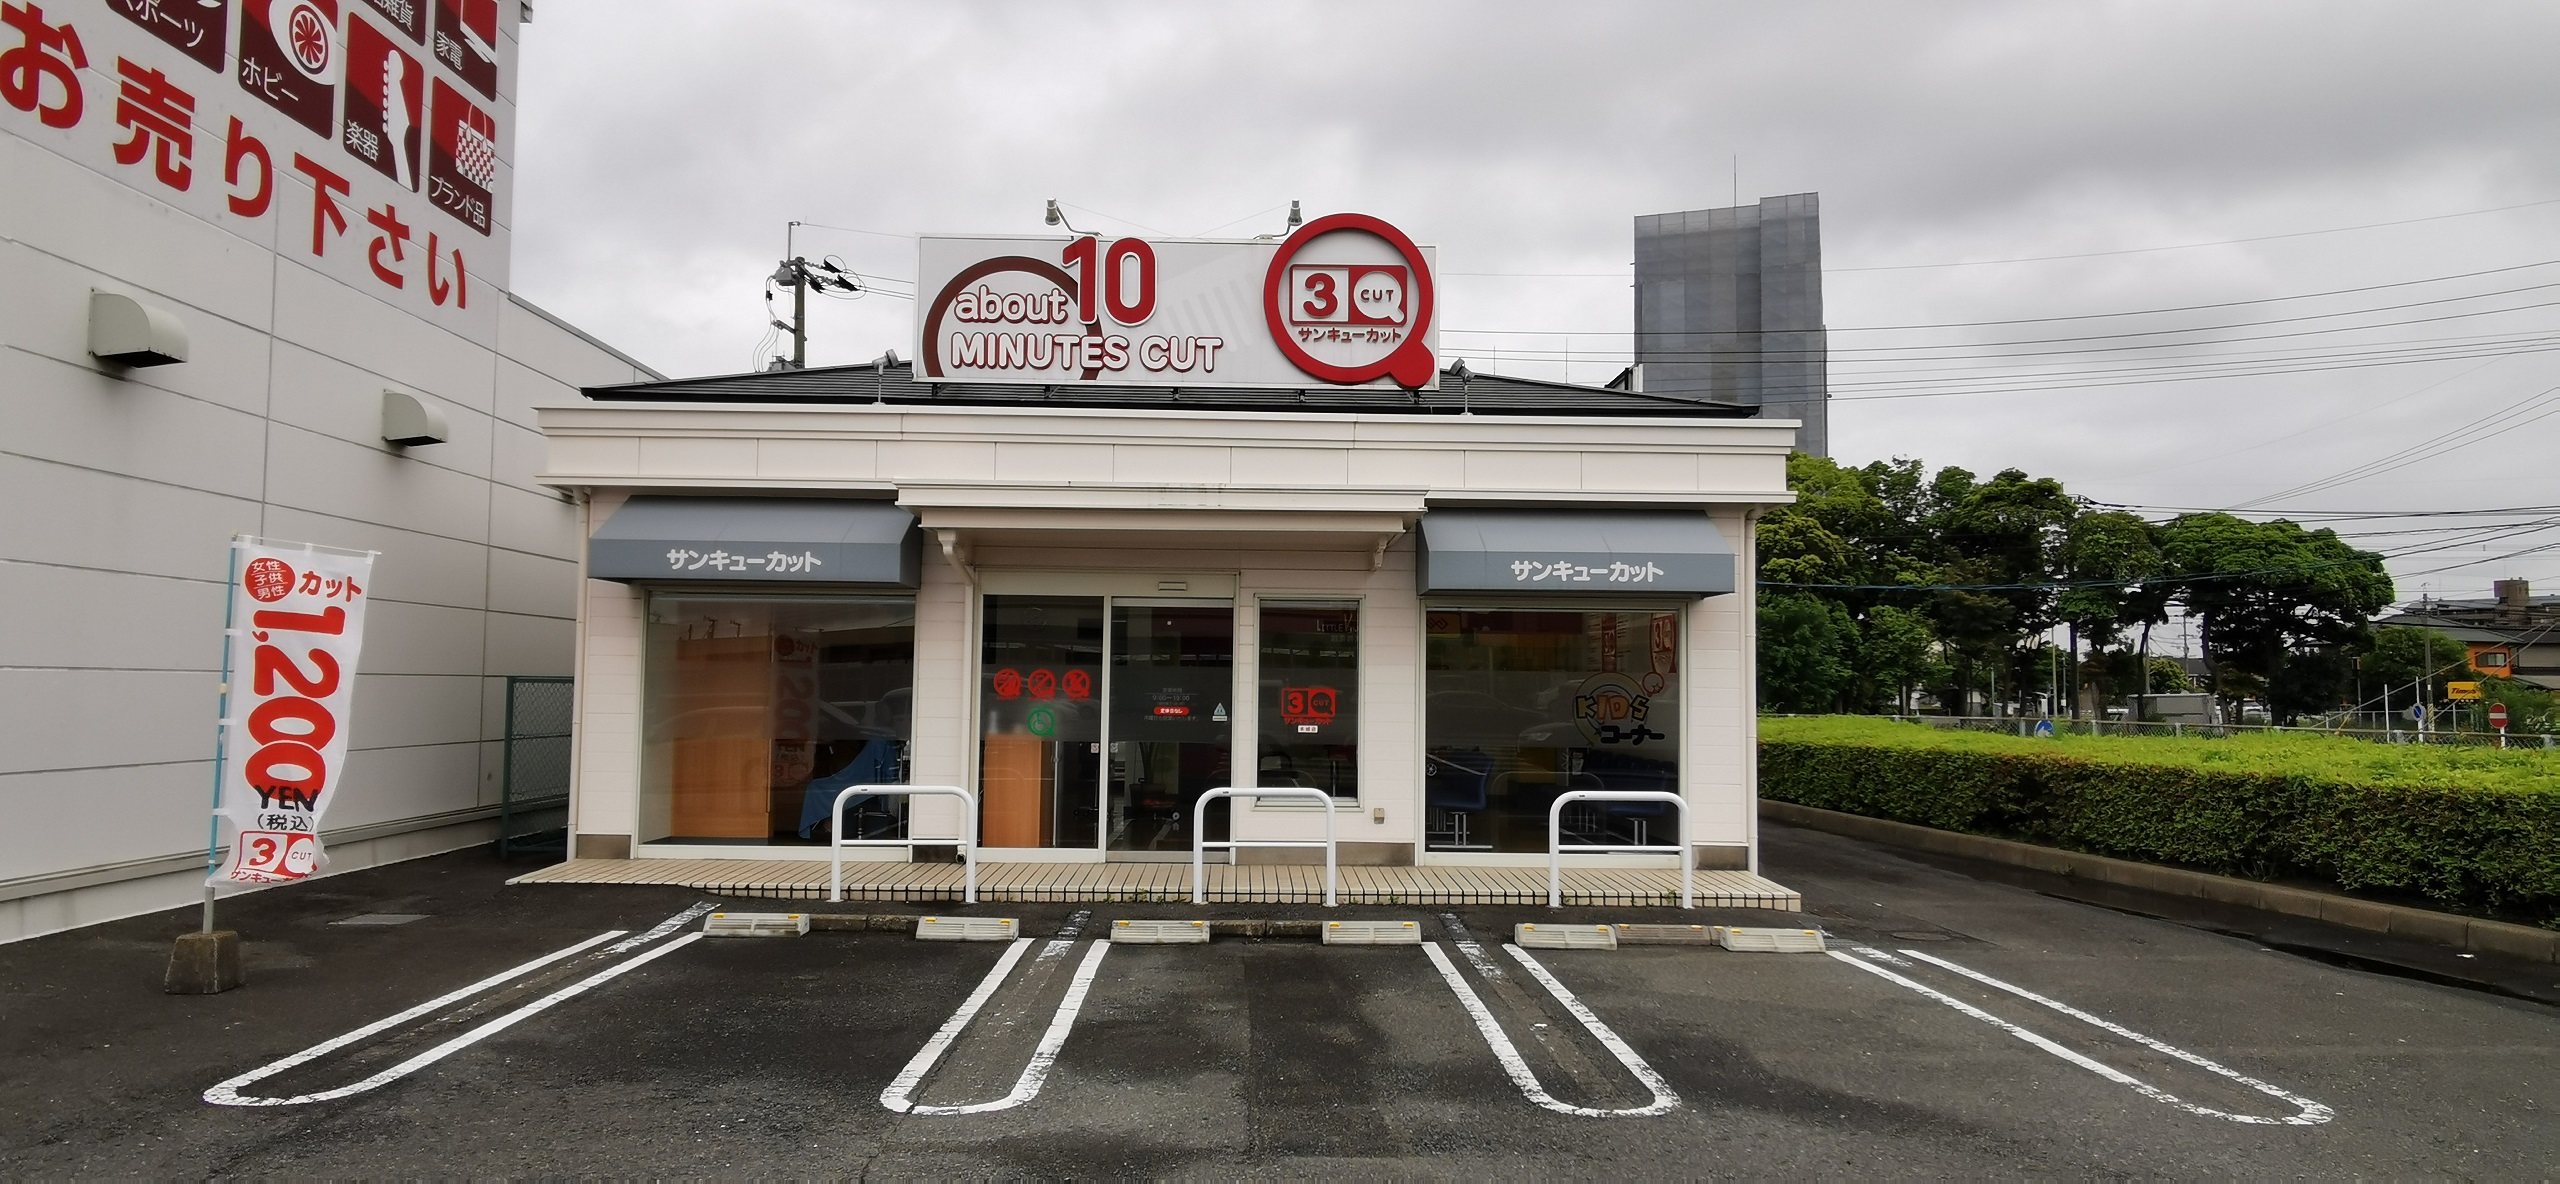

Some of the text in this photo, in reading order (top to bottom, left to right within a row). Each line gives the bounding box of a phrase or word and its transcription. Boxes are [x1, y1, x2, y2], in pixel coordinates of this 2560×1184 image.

[126, 0, 204, 47] ポーツ
[436, 30, 463, 71] 家電
[242, 57, 299, 101] ホビー
[346, 119, 379, 162] 楽器
[0, 1, 466, 310] お売り下さい
[430, 175, 486, 229] ブランド品
[953, 235, 1158, 327] about 10
[1360, 289, 1395, 303] CUT
[1299, 326, 1402, 345] サンキューカット
[950, 332, 1223, 374] MINUTES CUT
[252, 560, 282, 573] 女性
[666, 548, 822, 573] サンキューカット
[1510, 560, 1664, 582] サンキューカット
[254, 572, 284, 586] 子供
[257, 585, 286, 600] 男性
[298, 570, 362, 602] カット
[1575, 694, 1650, 721] KIDS
[1600, 723, 1666, 746] コーナー
[254, 785, 319, 812] YEN
[291, 851, 313, 861] CUT
